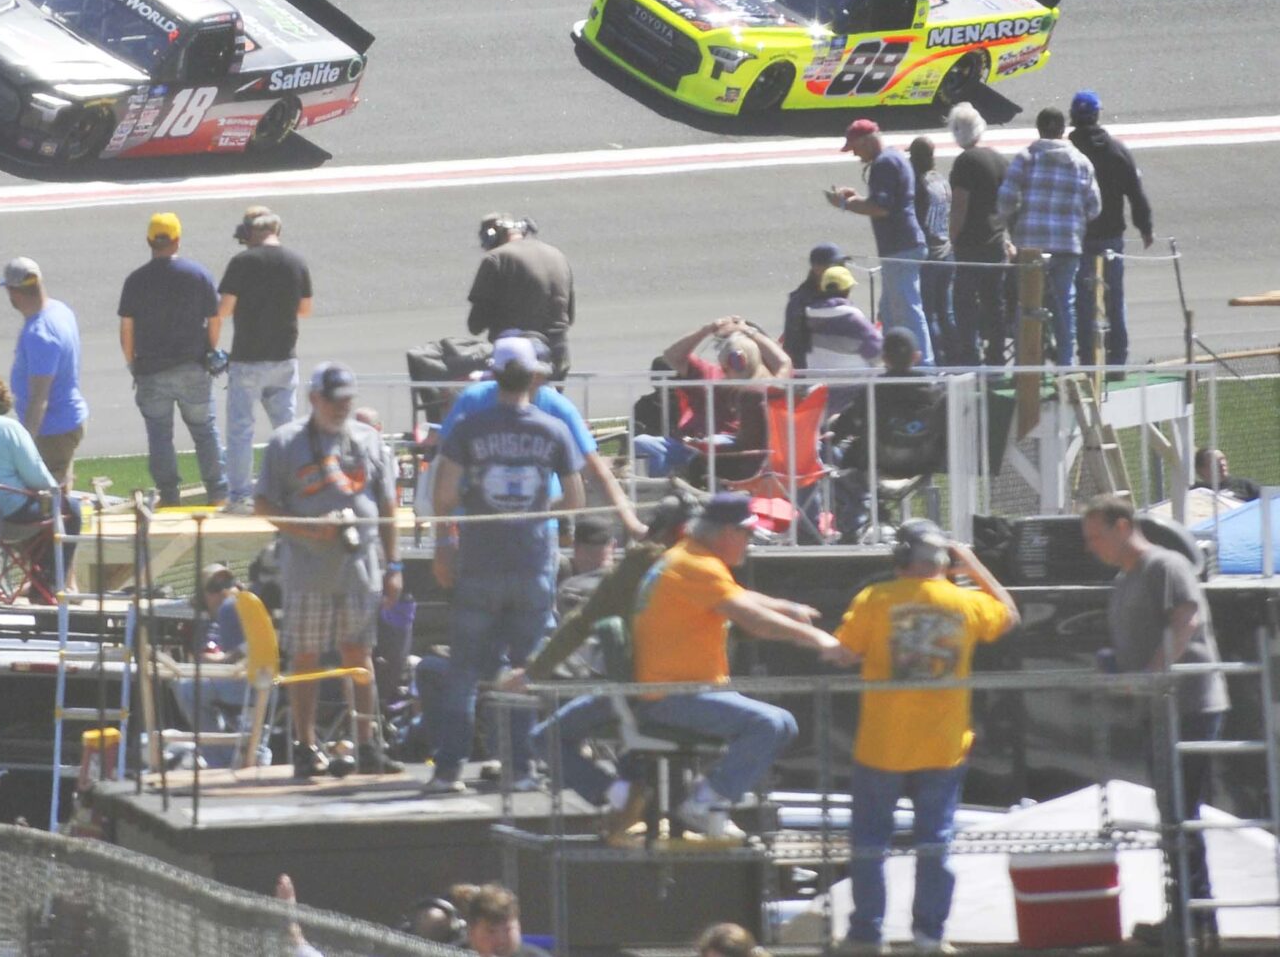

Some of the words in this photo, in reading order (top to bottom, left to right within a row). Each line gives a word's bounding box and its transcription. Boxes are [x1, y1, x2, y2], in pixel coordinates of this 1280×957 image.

[634, 5, 675, 40] TOYOTA
[926, 17, 1043, 48] MENARDS
[268, 62, 341, 91] Safelite
[824, 38, 912, 98] 88
[153, 86, 218, 138] 18
